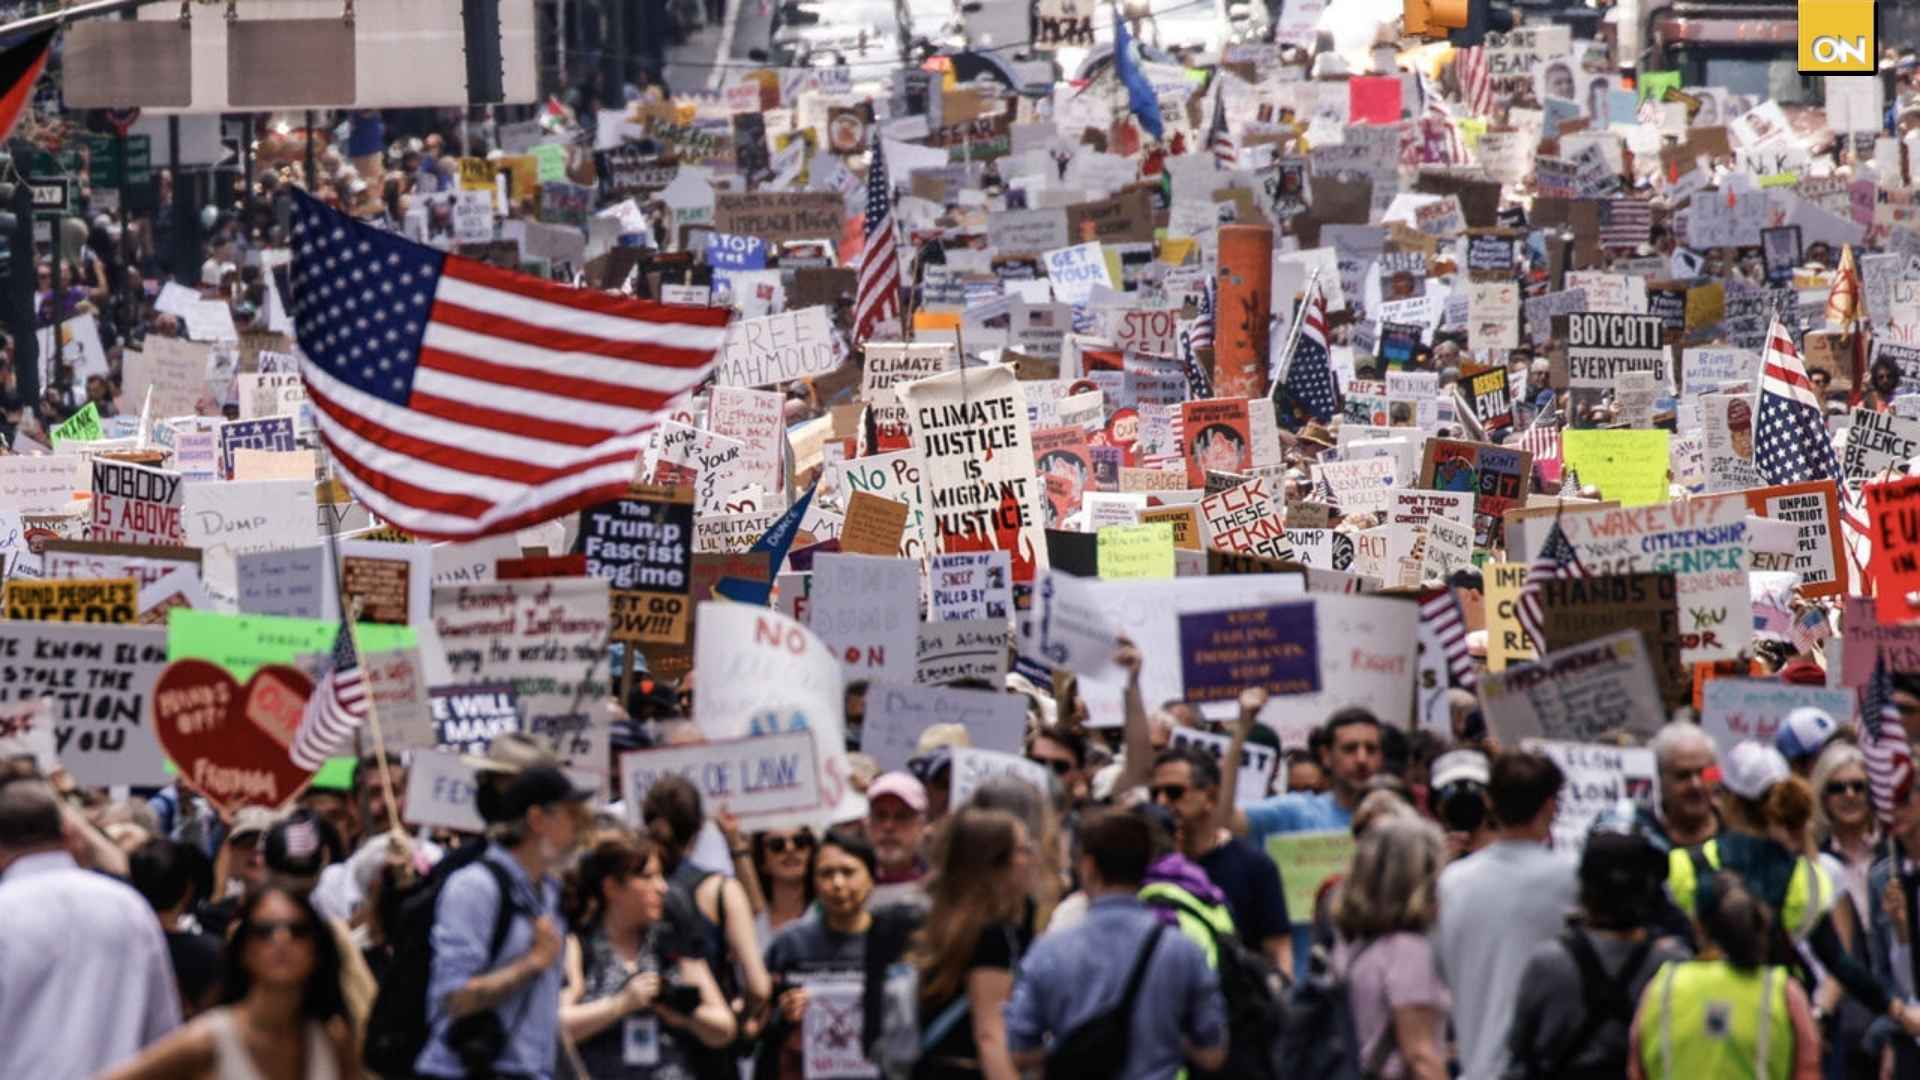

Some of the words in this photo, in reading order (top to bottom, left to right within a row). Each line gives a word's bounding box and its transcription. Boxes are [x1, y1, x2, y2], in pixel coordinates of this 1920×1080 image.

[706, 233, 761, 256] STOP
[1051, 247, 1088, 267] GET
[716, 253, 745, 264] THE
[1056, 263, 1104, 283] YOUR
[722, 314, 809, 361] FREE
[1569, 314, 1663, 348] BOYCOTT
[720, 344, 832, 385] MAHMOUD
[869, 356, 943, 374] CLIMATE
[1570, 357, 1663, 381] EVERYTHING
[920, 397, 1015, 430] CLIMATE
[1476, 391, 1508, 420] EVIL
[1855, 410, 1897, 440] WILL
[664, 430, 697, 448] HOW
[925, 425, 1018, 459] JUSTICE
[1849, 426, 1917, 460] SILENCE
[698, 445, 741, 472] YOUR
[964, 459, 982, 480] IS
[1844, 446, 1868, 466] BE
[92, 463, 182, 504] NOBODY
[846, 464, 886, 491] NO
[929, 478, 1027, 510] MIGRANT
[1200, 478, 1269, 521] FCK
[1778, 496, 1831, 512] UNPAID
[94, 495, 112, 526] IS
[122, 502, 182, 543] ABOVE
[620, 502, 651, 517] The
[933, 505, 1032, 538] JUSTICE
[1211, 502, 1270, 534] THESE
[1587, 504, 1665, 539] WAKE
[1778, 508, 1833, 524] PATRIOT
[592, 515, 682, 543] Trump
[698, 517, 772, 536] FACILITATE
[1430, 525, 1469, 550] AMERICA
[586, 537, 683, 564] Fascist
[1359, 536, 1388, 560] ACT
[1651, 547, 1744, 575] GENDER
[587, 561, 684, 590] Regime
[9, 584, 53, 605] FUND
[58, 583, 135, 604] PEOPLE'S
[647, 593, 683, 616] GO
[1546, 580, 1647, 607] HANDS
[609, 613, 674, 639] OW!!!
[1689, 606, 1727, 630] YOU
[755, 617, 806, 655] NO
[34, 638, 103, 660] KNOW
[115, 643, 168, 664] ELON
[3, 667, 78, 689] STOLE
[87, 669, 134, 691] THE
[450, 695, 515, 718] WILL
[54, 727, 125, 757] YOU
[742, 755, 801, 792] LAW
